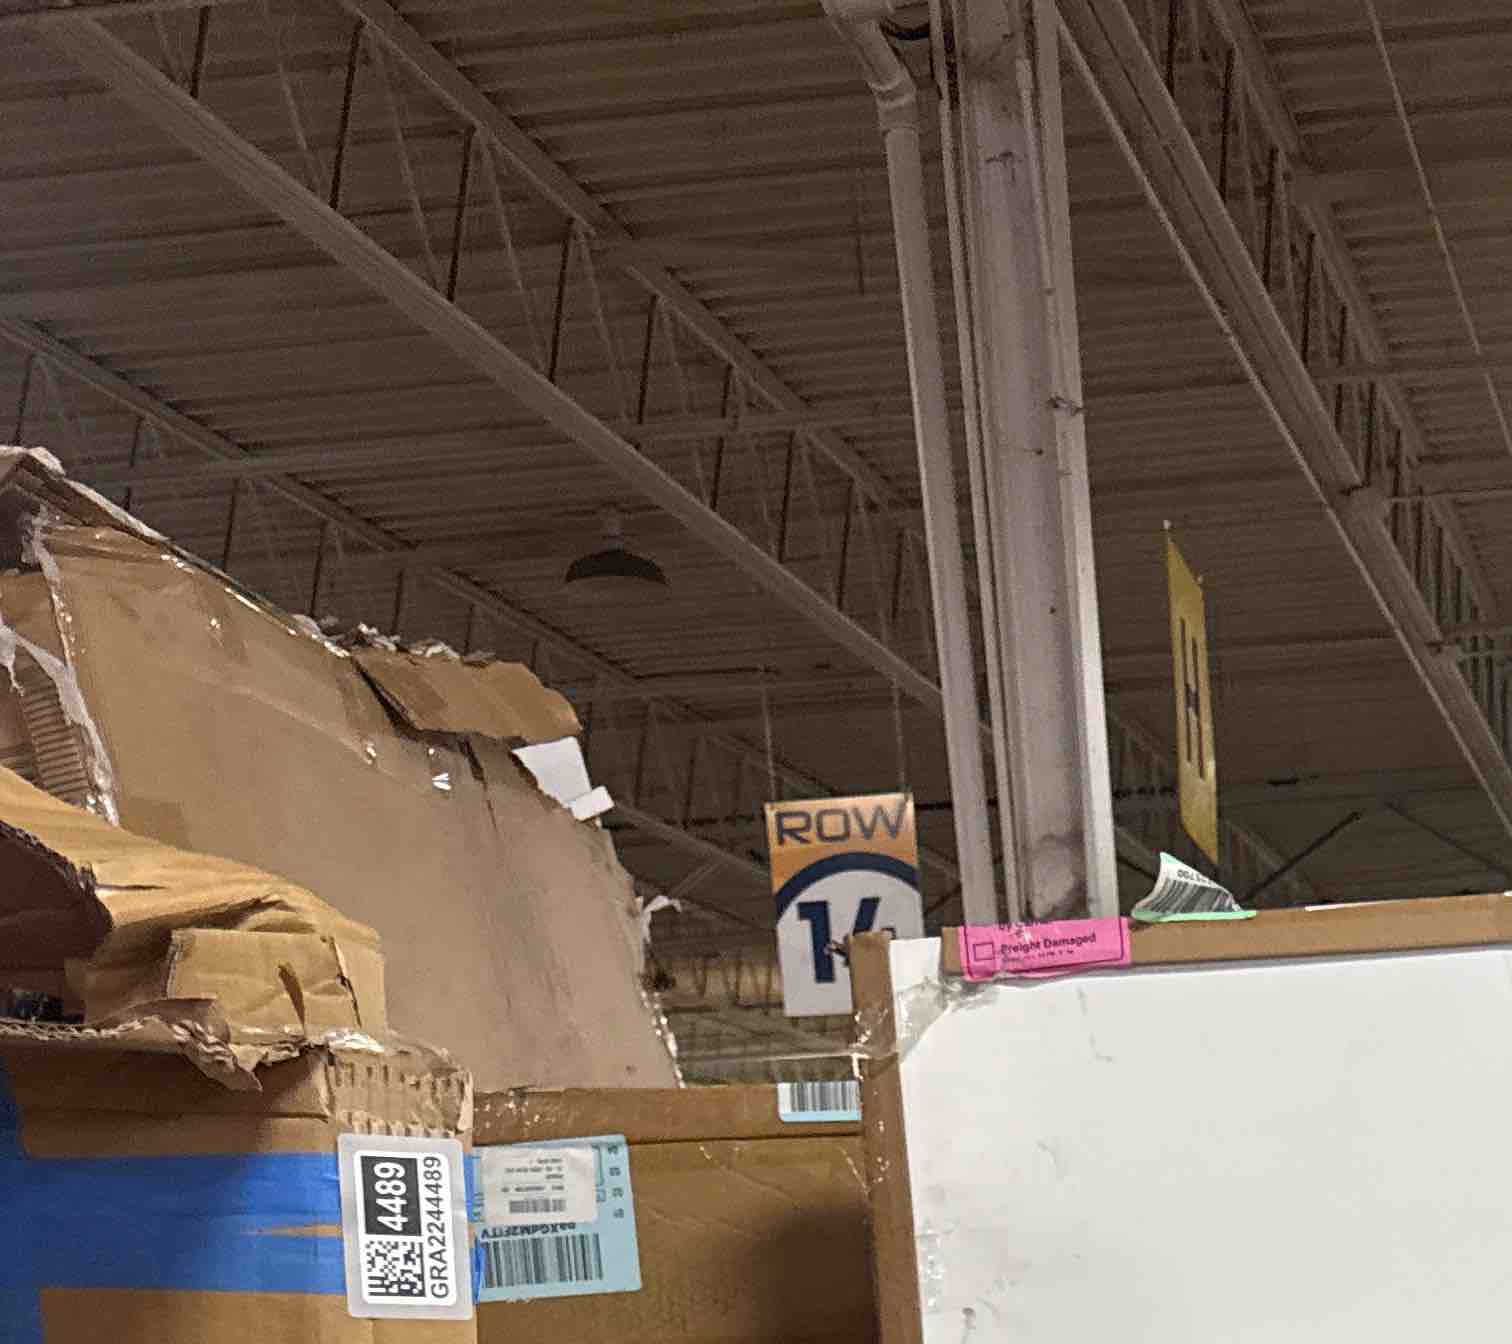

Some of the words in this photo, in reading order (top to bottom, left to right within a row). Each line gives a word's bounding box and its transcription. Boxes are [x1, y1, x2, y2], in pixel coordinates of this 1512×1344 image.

[775, 804, 907, 846] ROW
[1043, 933, 1096, 949] Damaged
[373, 1161, 409, 1232] 4489
[423, 1156, 449, 1299] GRA2244489
